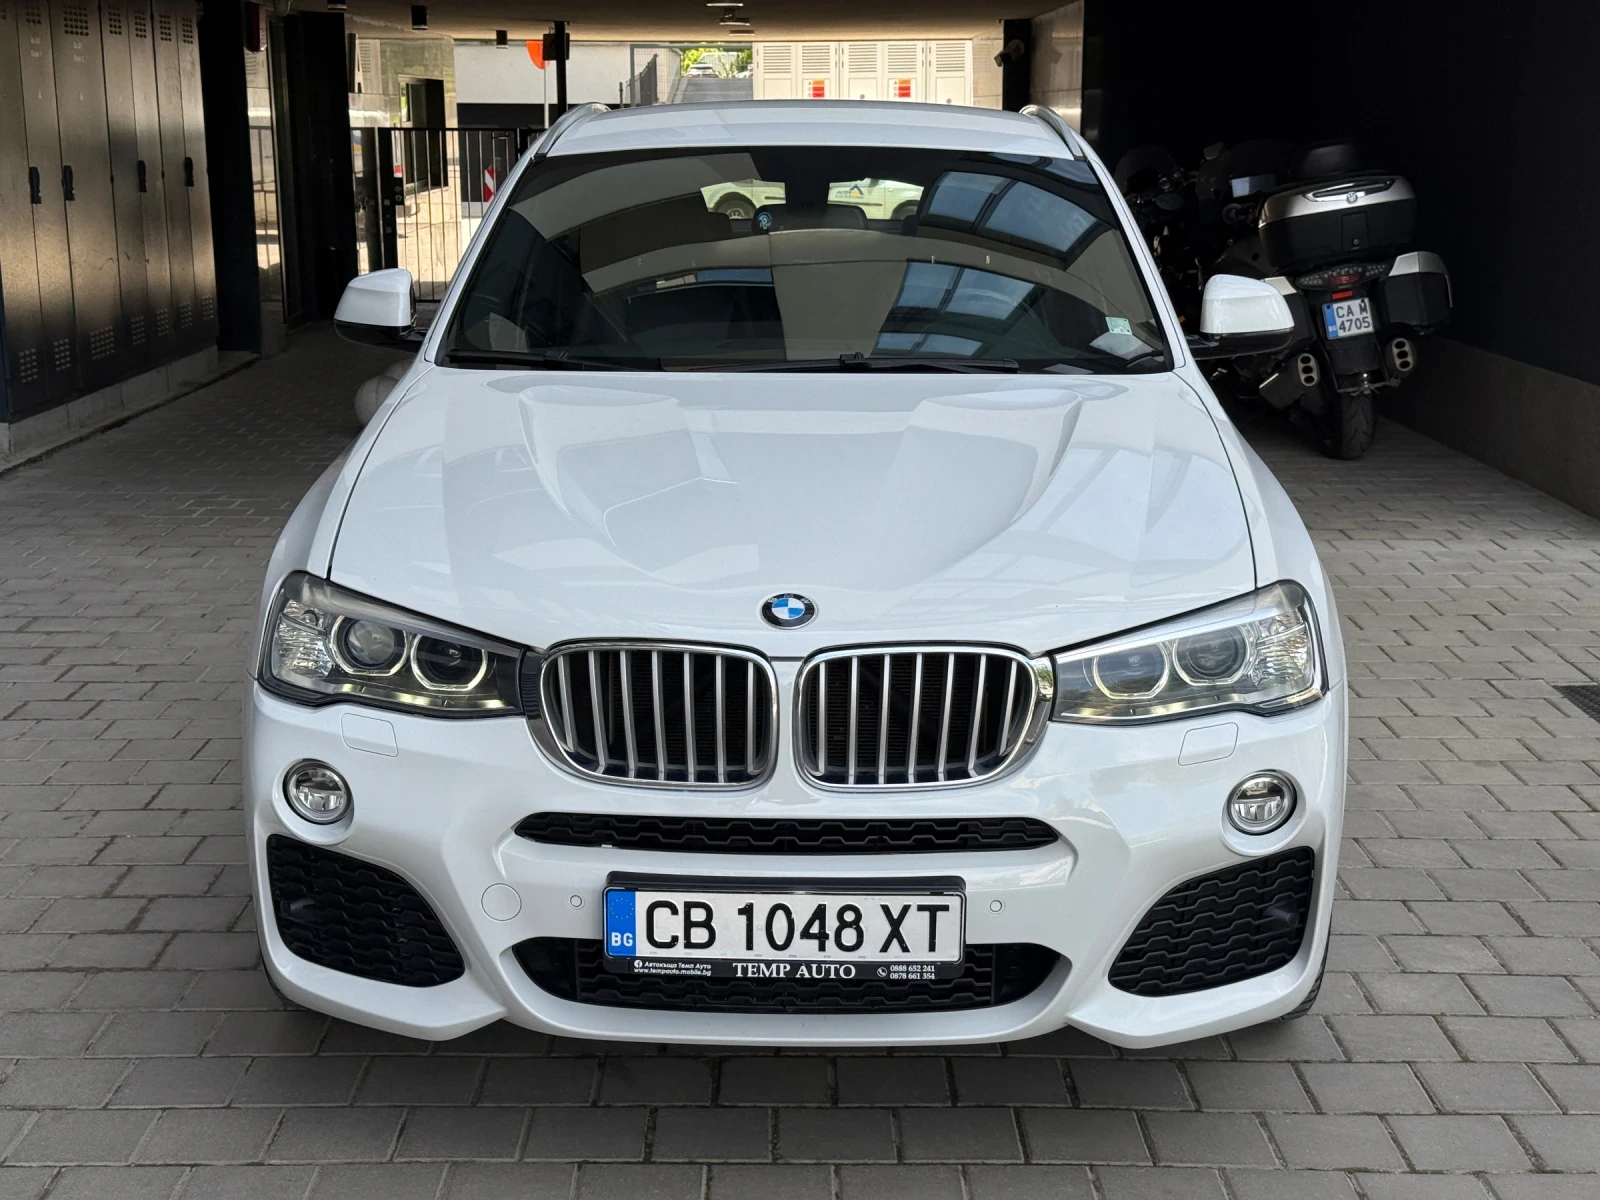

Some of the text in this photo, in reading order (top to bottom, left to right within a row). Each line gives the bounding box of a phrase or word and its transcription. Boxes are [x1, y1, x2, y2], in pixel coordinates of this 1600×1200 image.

[1336, 305, 1354, 318] CA
[1339, 316, 1370, 332] 4705
[646, 900, 950, 953] CB 1048 XT
[611, 932, 633, 947] BG
[732, 962, 856, 979] TEMP AUTO
[889, 964, 936, 972] 0888 652 241
[889, 972, 936, 980] 0878 661 354
